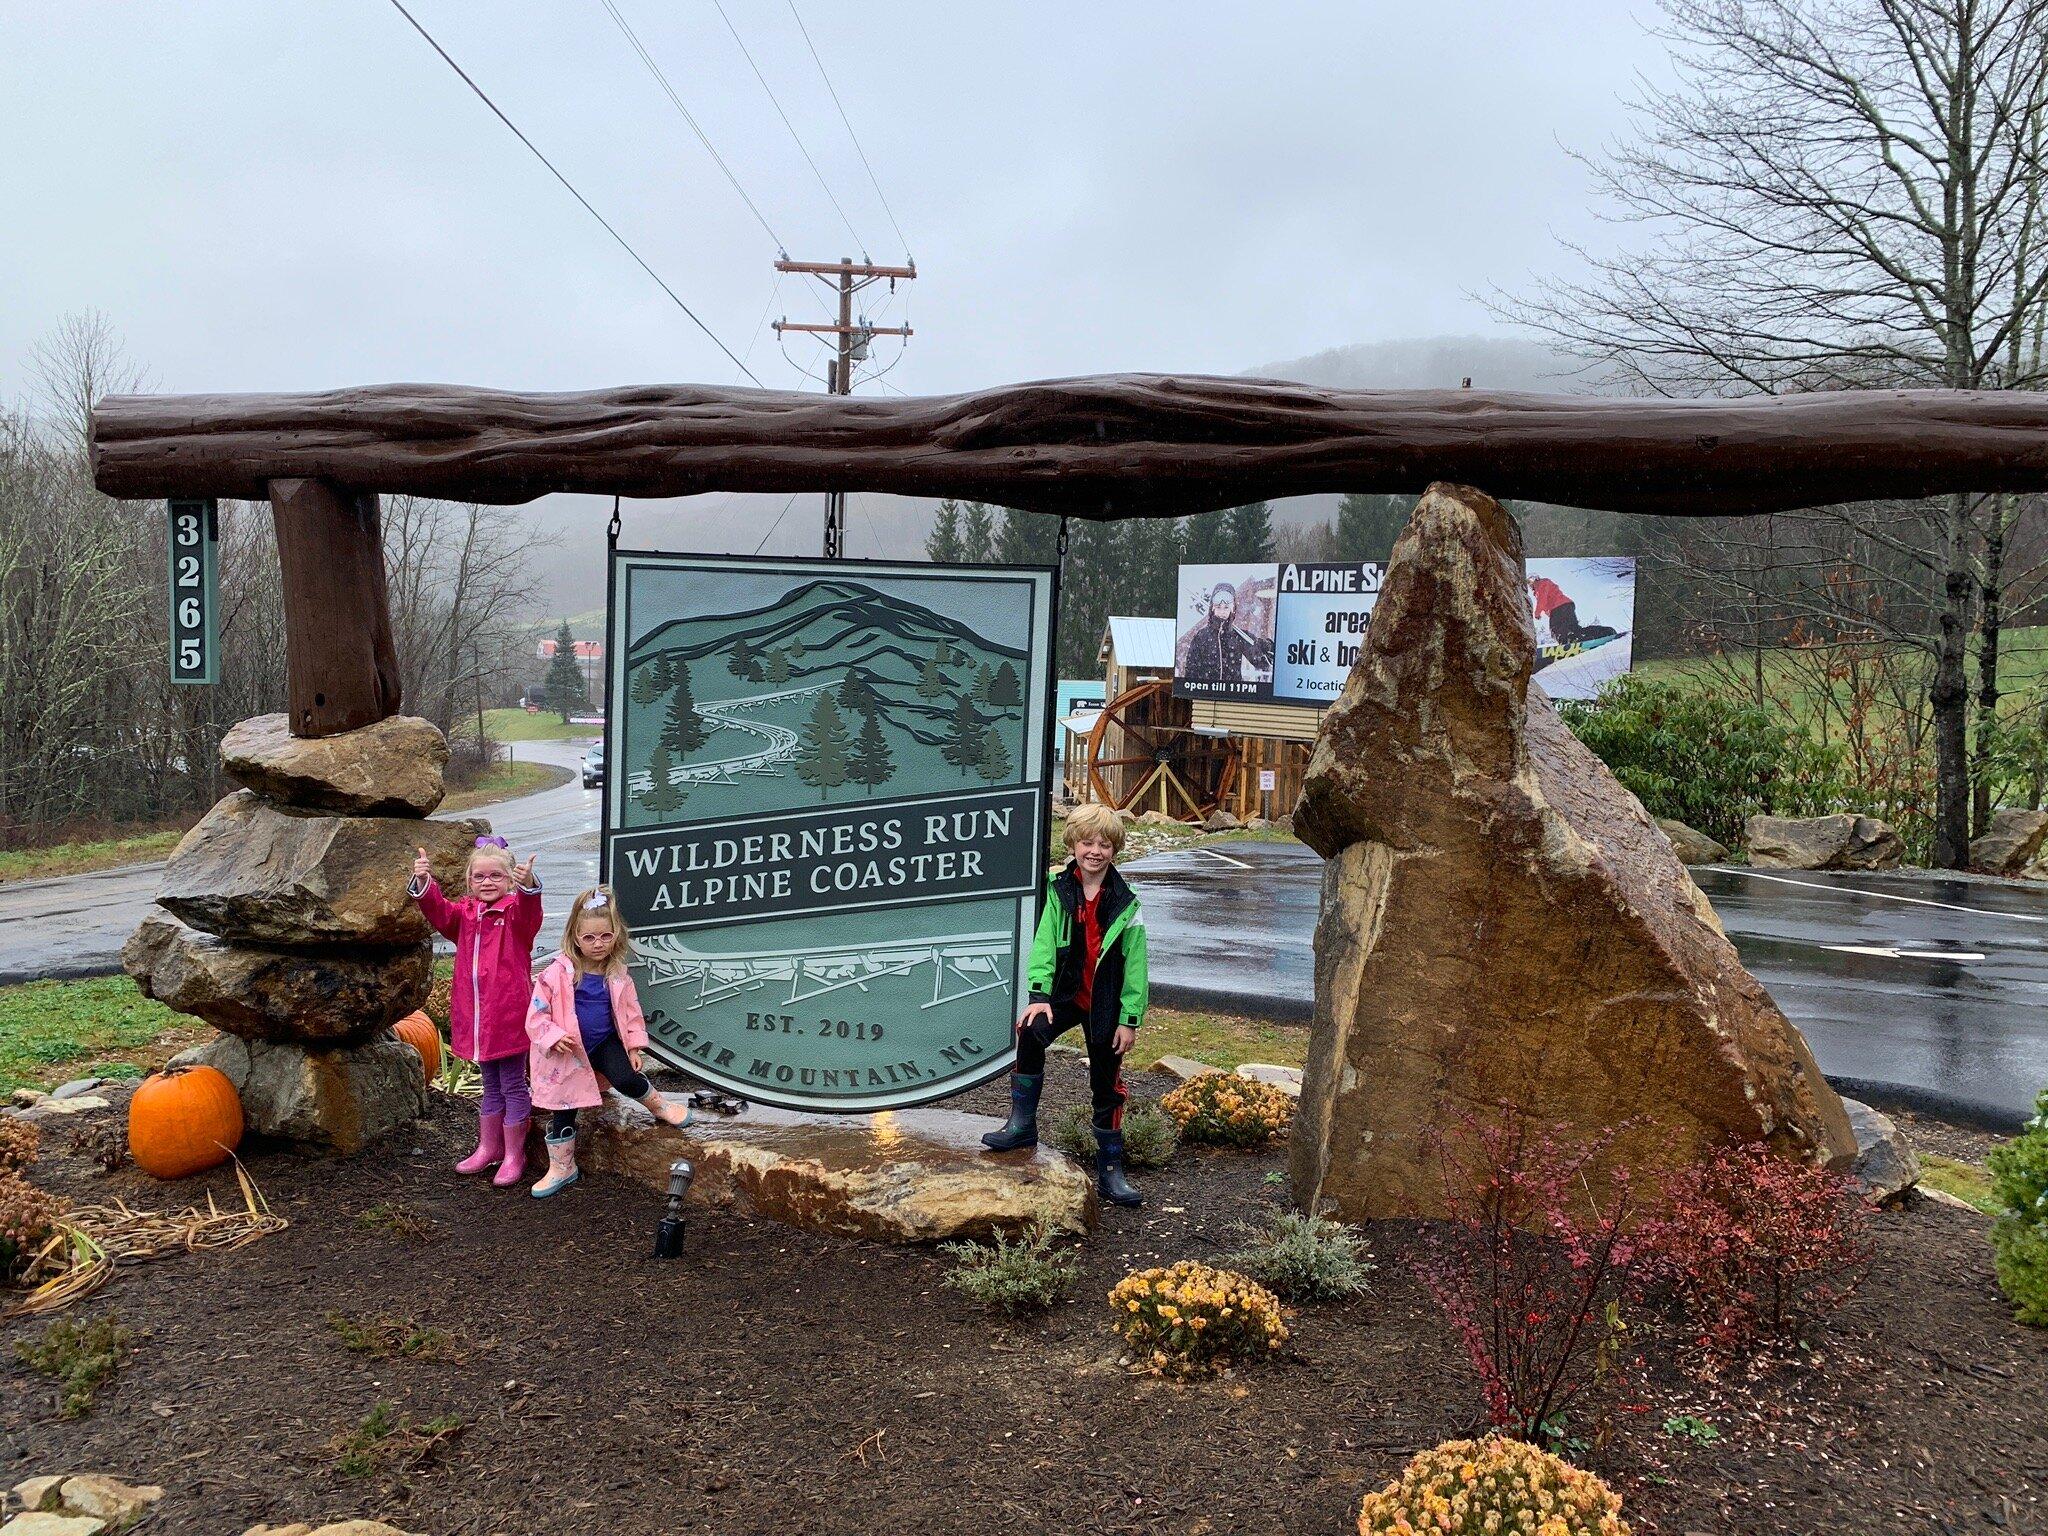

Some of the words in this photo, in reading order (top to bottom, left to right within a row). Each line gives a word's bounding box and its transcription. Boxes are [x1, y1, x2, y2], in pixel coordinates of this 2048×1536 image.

[177, 514, 201, 670] 3265
[1281, 563, 1357, 592] ALPINE
[1287, 639, 1316, 665] ski
[1320, 646, 1331, 663] &
[1184, 681, 1209, 692] open
[1211, 682, 1226, 692] till
[1229, 683, 1257, 693] 11PM
[1296, 678, 1304, 689] 2
[625, 819, 903, 878] WILDERNESS
[923, 806, 1015, 845] RUN
[649, 869, 792, 912] ALPINE
[810, 850, 985, 894] COASTER
[746, 1012, 804, 1035] EST.
[818, 1018, 885, 1042] 2019
[644, 1009, 736, 1068] SUGAR
[748, 1059, 937, 1087] MOUNTAIN,
[939, 1036, 984, 1066] NC
